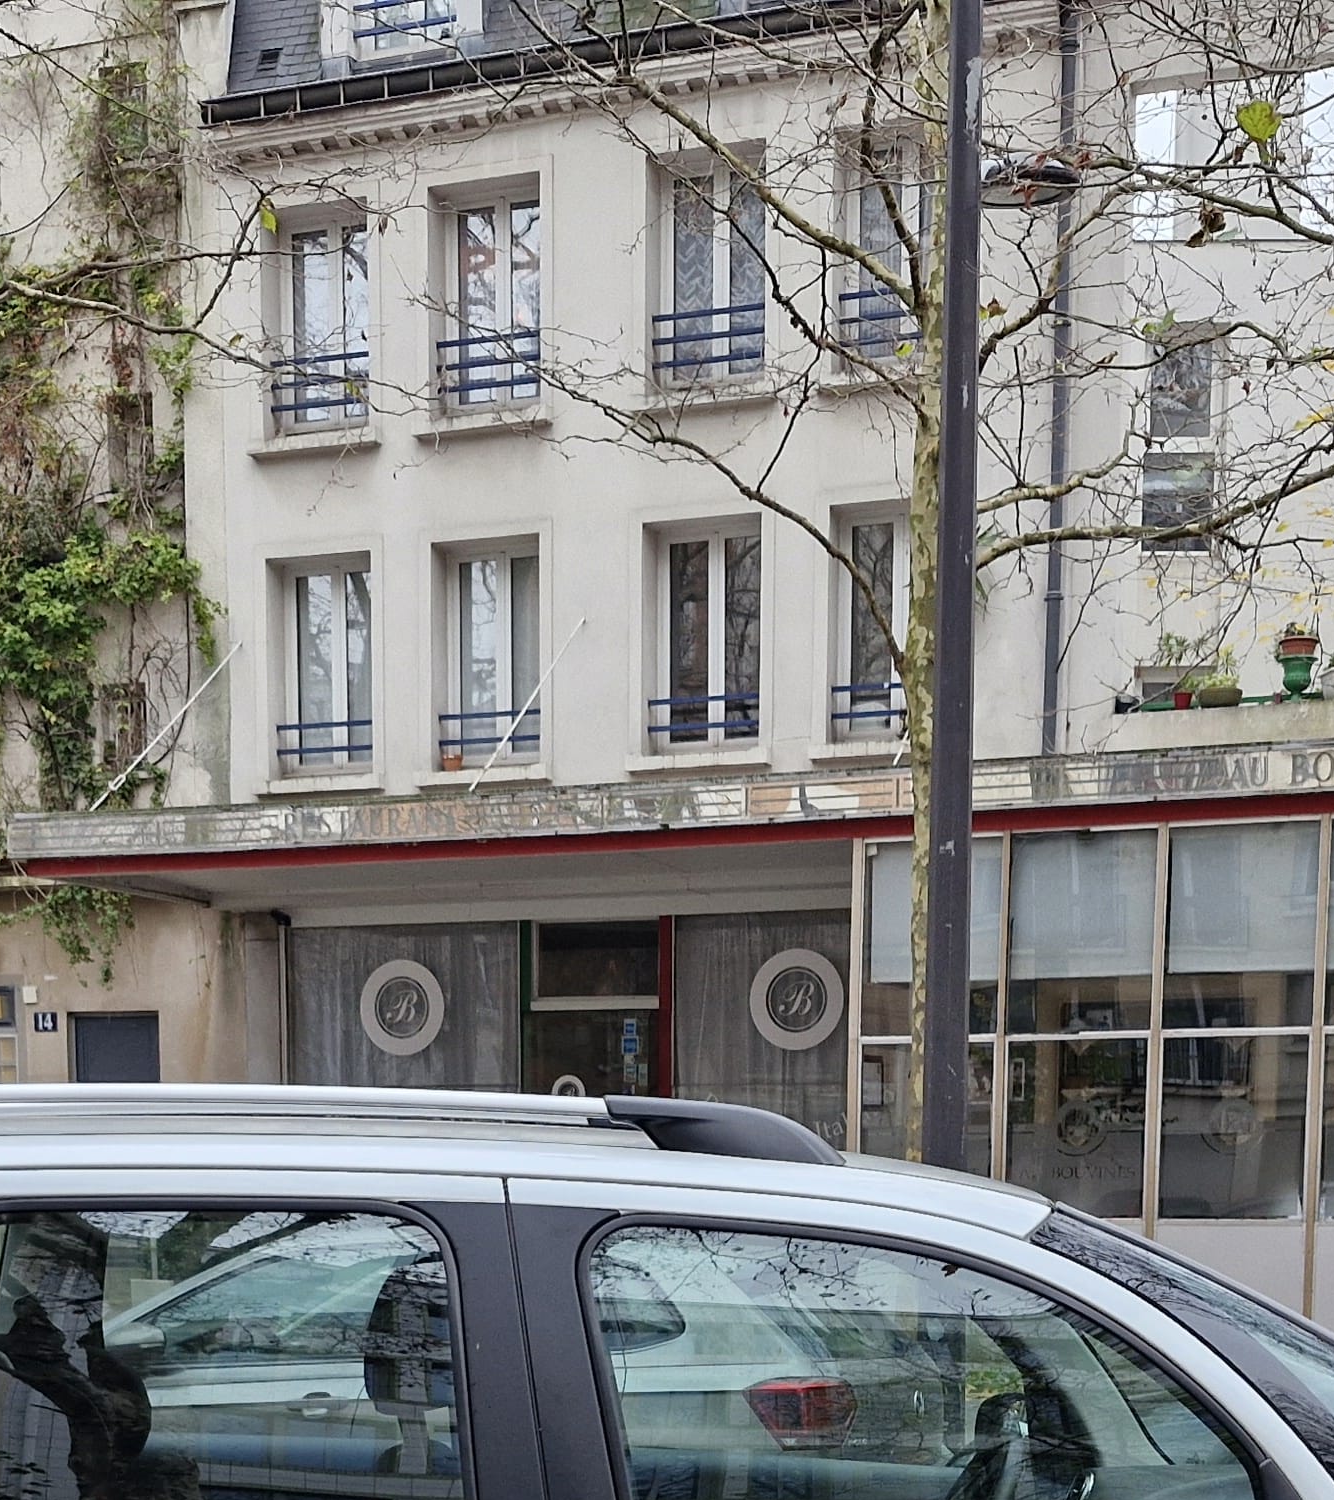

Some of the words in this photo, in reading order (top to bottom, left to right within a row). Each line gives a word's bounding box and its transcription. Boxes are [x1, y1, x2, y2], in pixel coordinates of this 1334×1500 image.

[386, 989, 418, 1022] B
[779, 981, 814, 1016] B
[38, 1013, 53, 1030] 14
